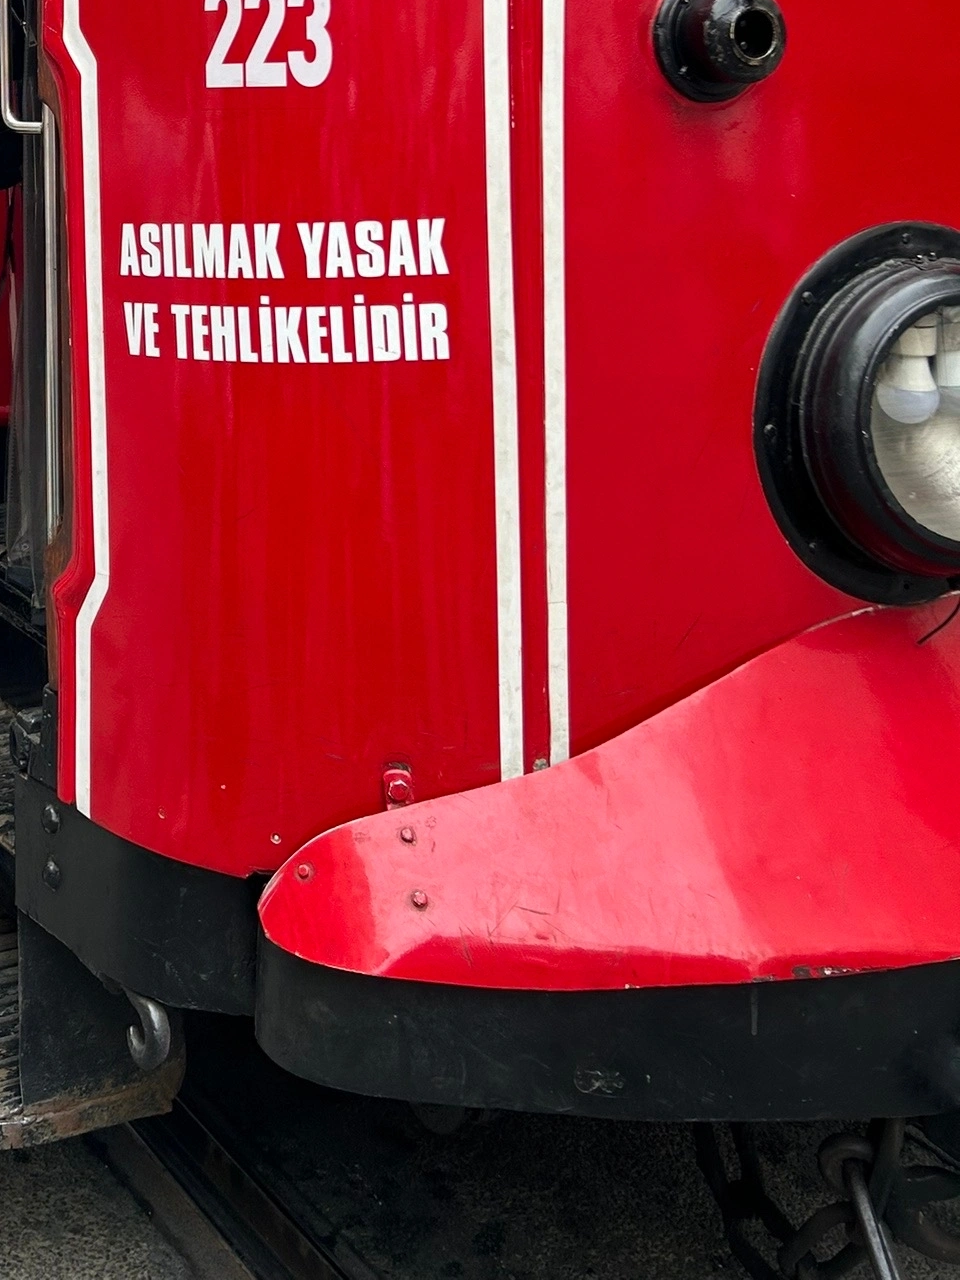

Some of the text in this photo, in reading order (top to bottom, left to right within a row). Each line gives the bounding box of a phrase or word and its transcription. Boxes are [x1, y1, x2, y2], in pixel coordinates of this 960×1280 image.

[120, 217, 450, 279] ASILMAK YASAK
[124, 292, 451, 364] VE TEHLİKELİDİR
